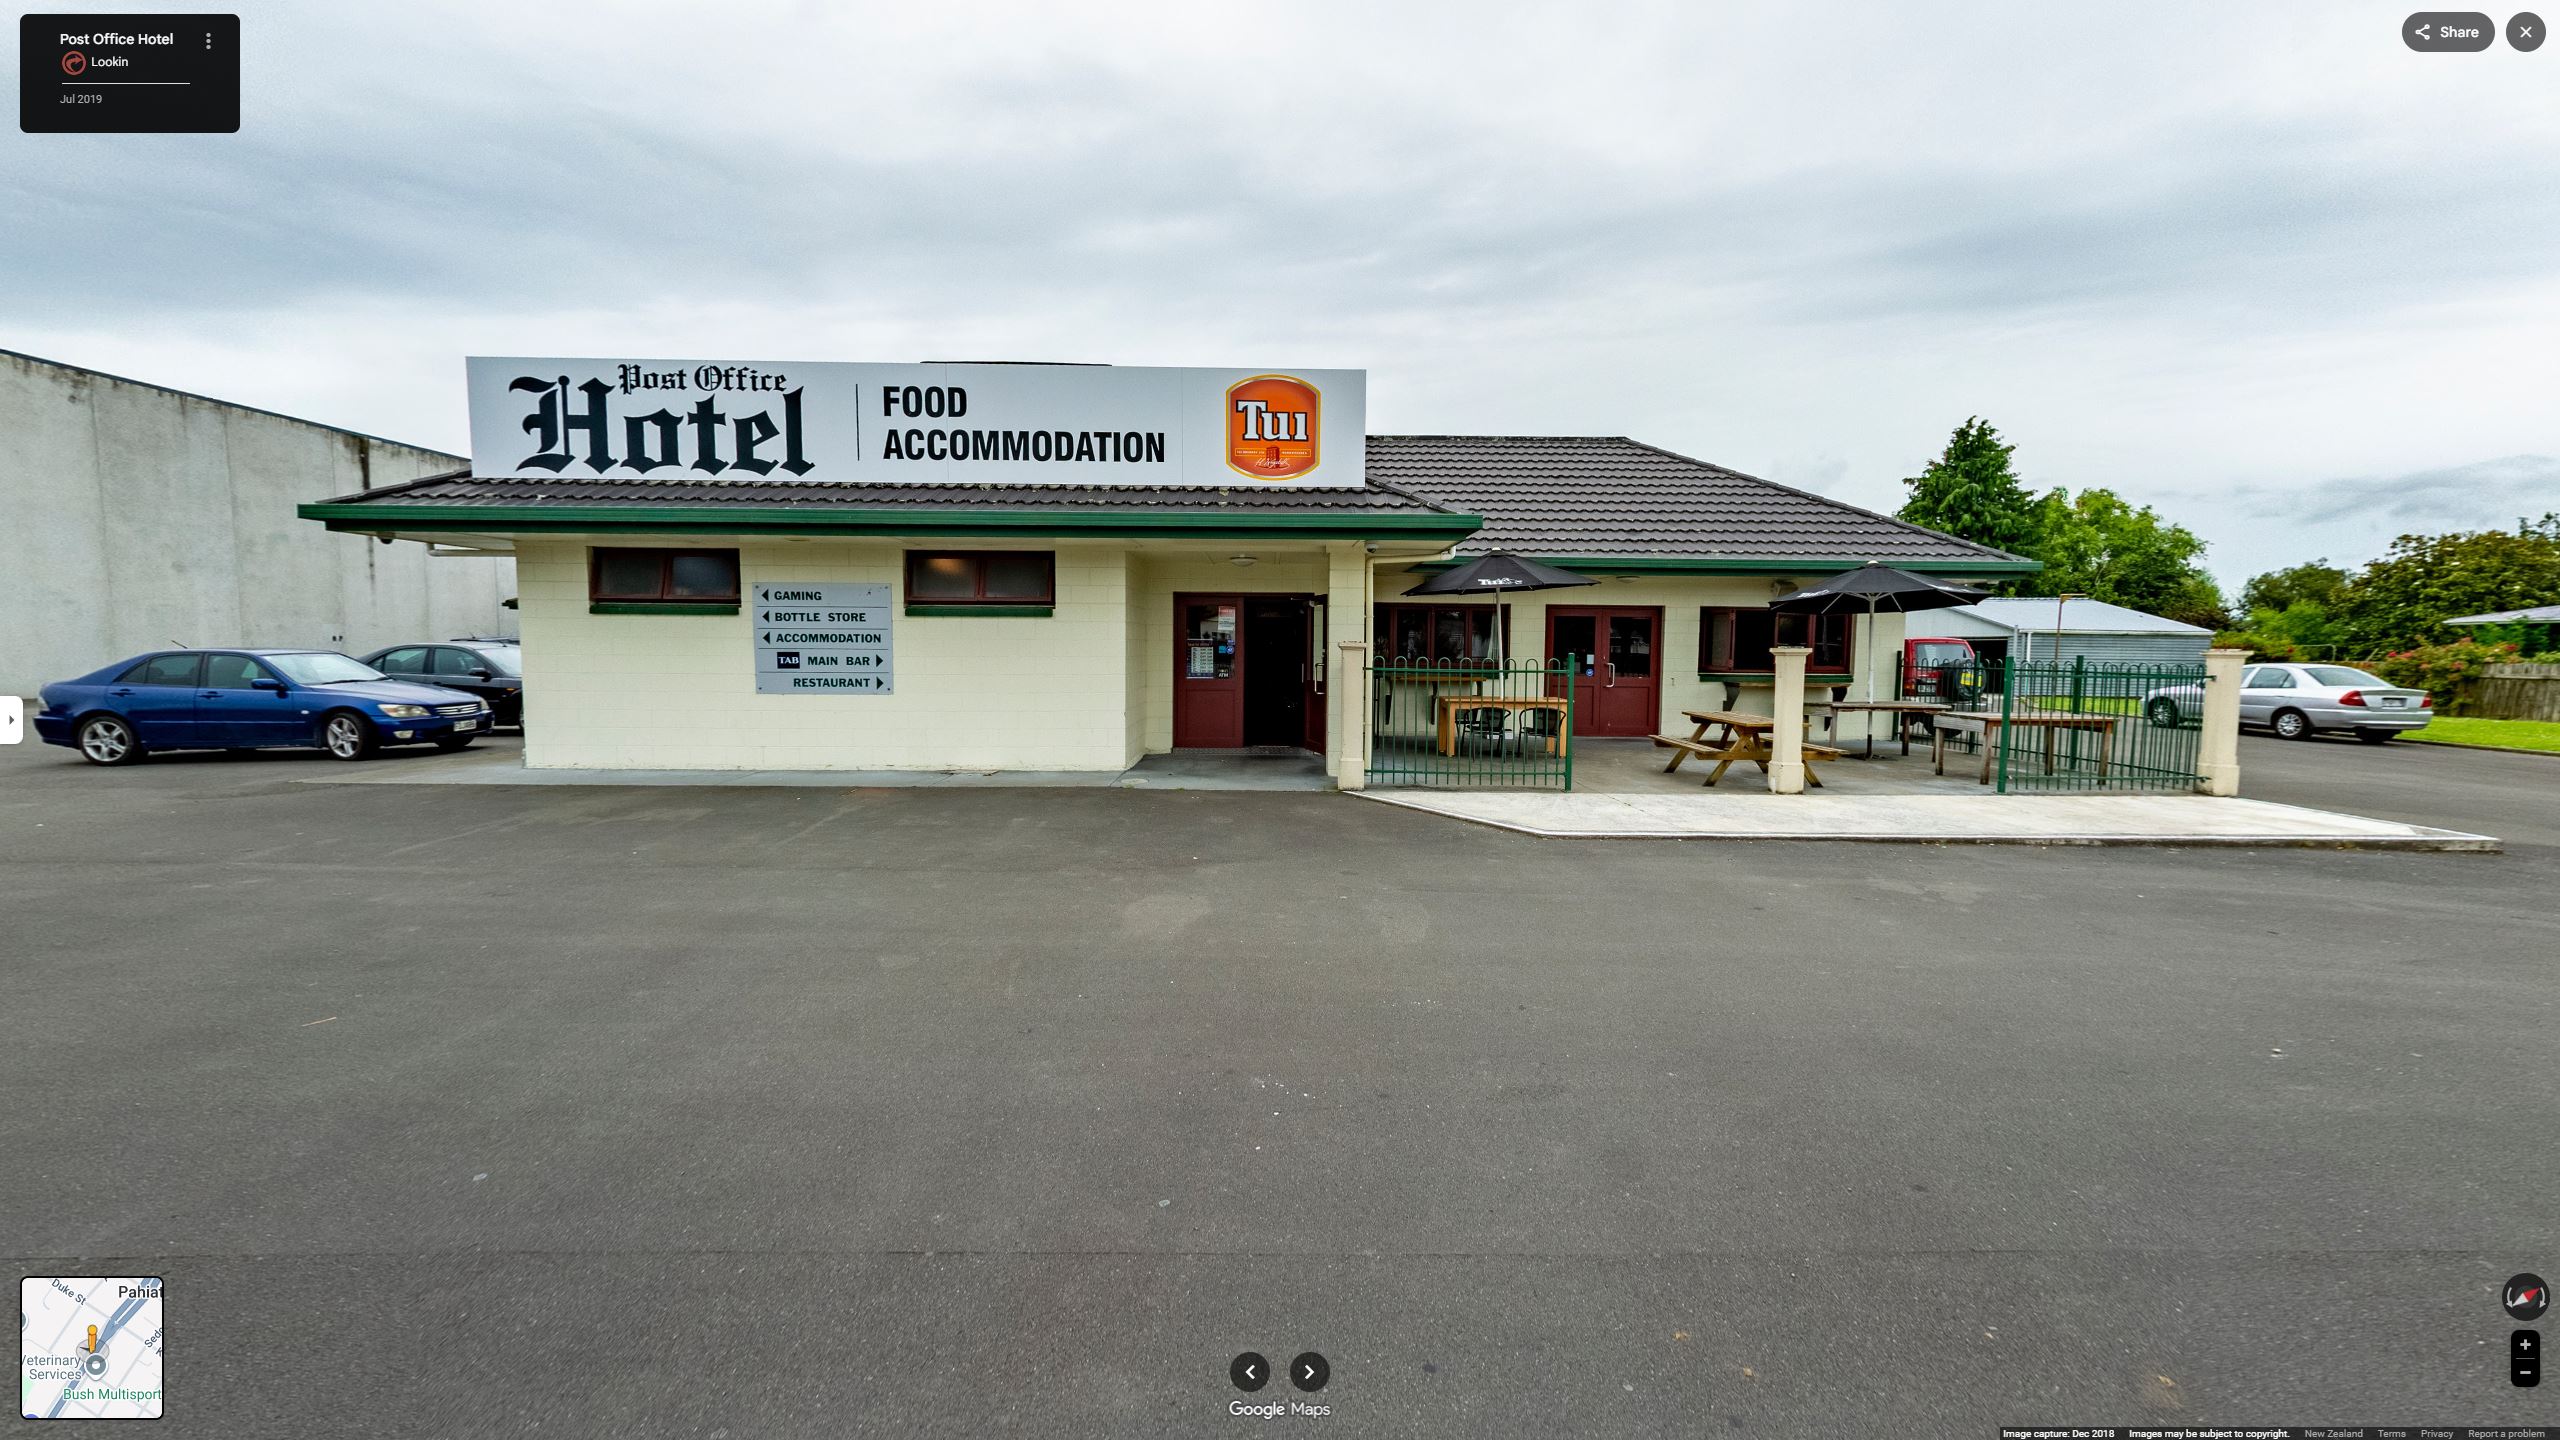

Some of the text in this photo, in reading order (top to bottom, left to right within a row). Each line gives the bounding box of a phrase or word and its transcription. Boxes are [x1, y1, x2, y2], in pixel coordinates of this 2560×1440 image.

[617, 363, 787, 395] Post Office
[882, 385, 968, 418] FOOD
[508, 375, 816, 477] Hotel
[1236, 400, 1309, 442] Tui
[882, 429, 1166, 463] ACCOMMODATION
[774, 591, 822, 600] GAMING
[775, 612, 866, 622] BOTTLE STORE
[776, 633, 881, 643] ACCOMMODATION
[778, 656, 799, 664] TAB
[807, 656, 870, 666] MAIN BAR
[793, 678, 870, 687] RESTAURANT
